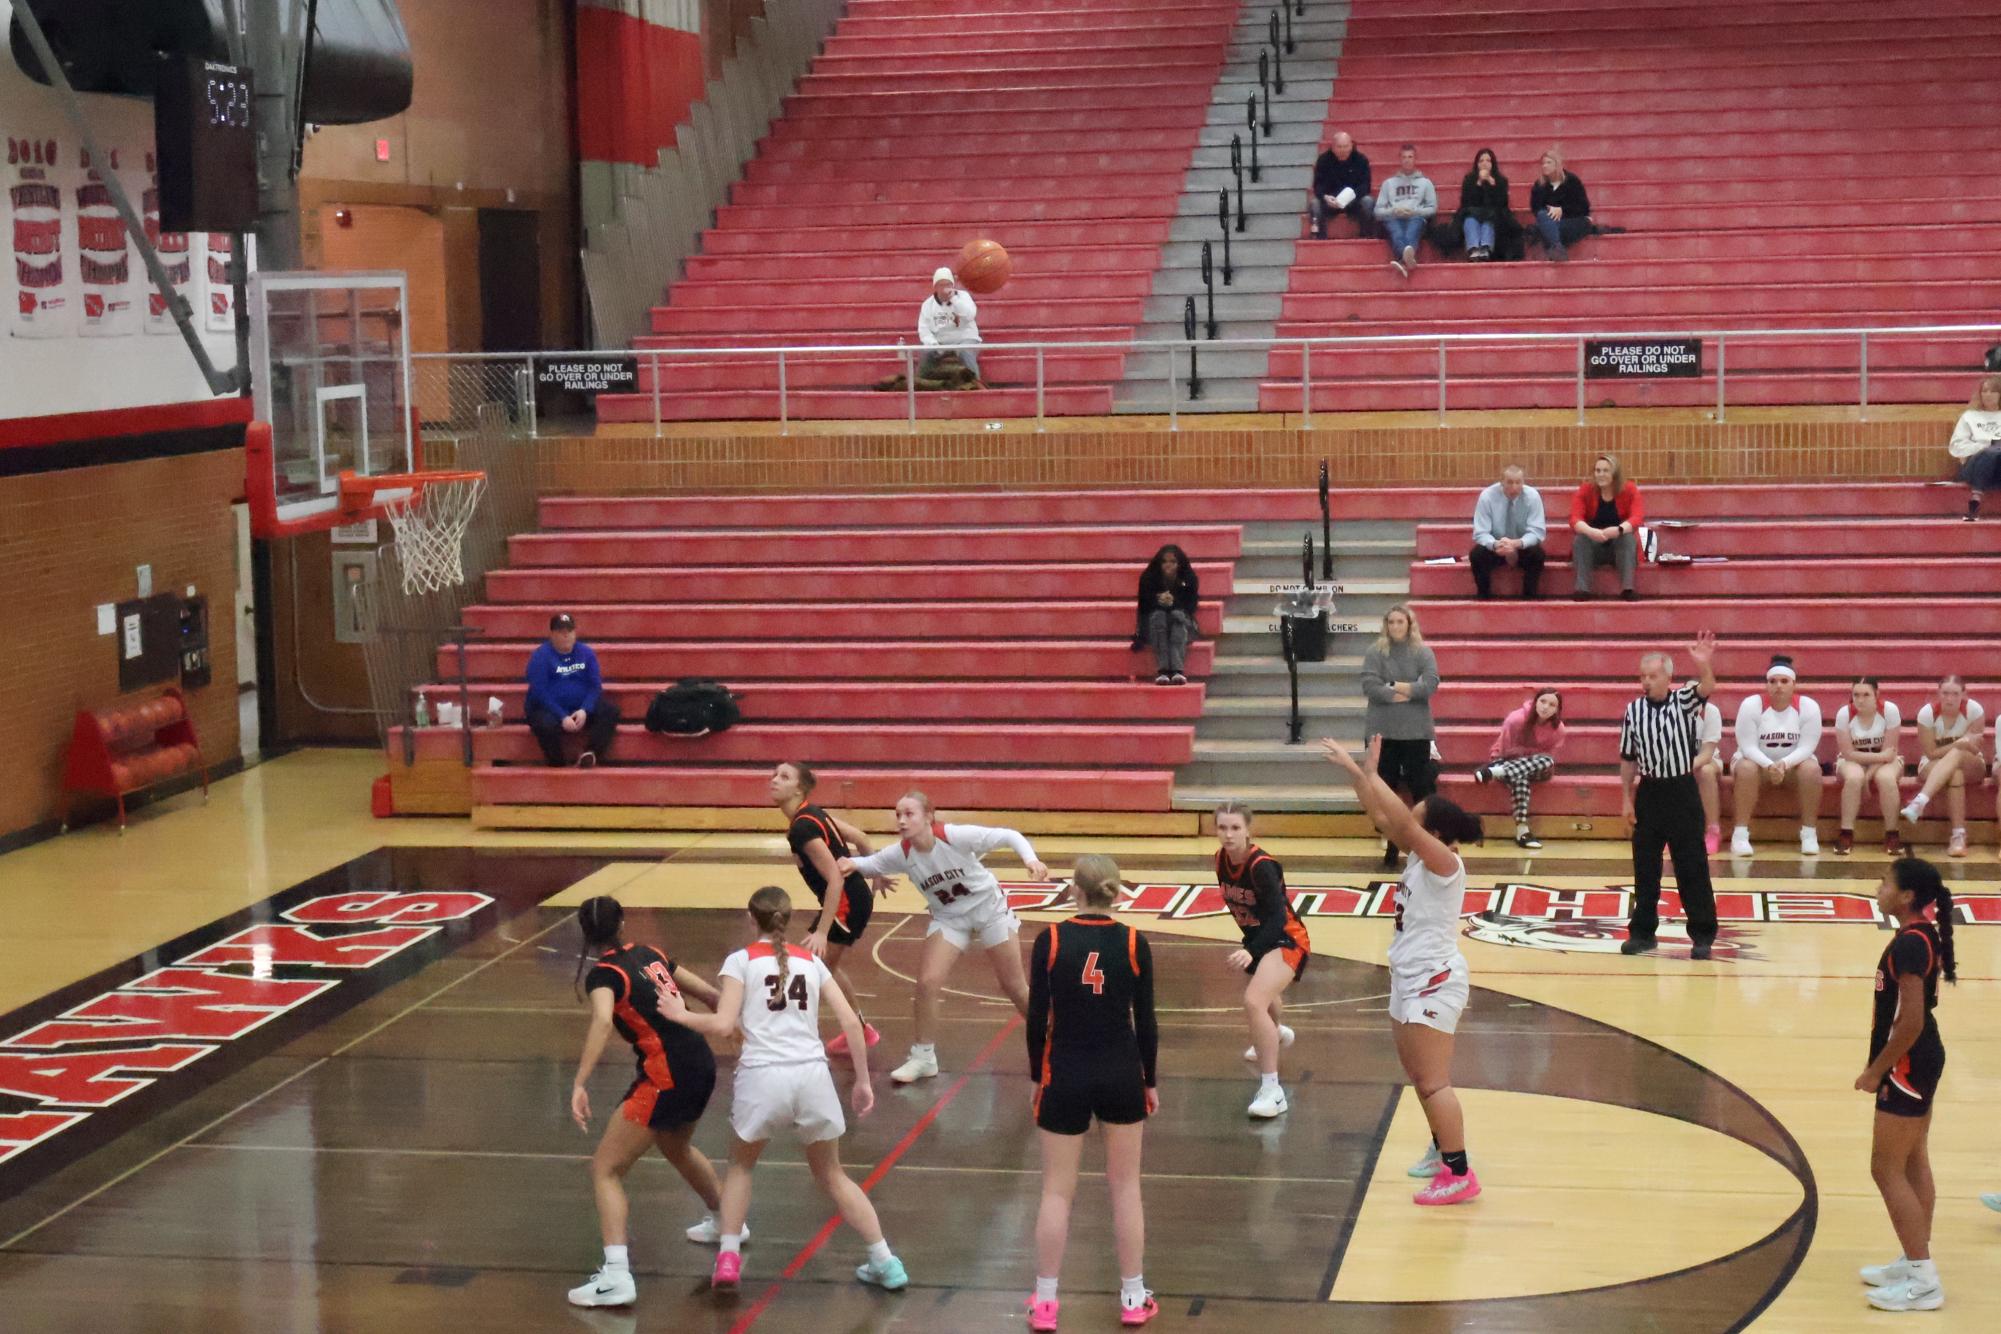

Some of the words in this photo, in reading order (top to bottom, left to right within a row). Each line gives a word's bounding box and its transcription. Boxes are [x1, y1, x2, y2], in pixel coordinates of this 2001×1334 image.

[1602, 346, 1642, 355] PLEASE
[1645, 346, 1660, 355] DO
[1663, 346, 1685, 354] NOT
[1591, 356, 1607, 365] GO
[1610, 356, 1638, 364] OVER
[1641, 355, 1656, 364] OR
[1659, 355, 1696, 363] UNDER
[548, 364, 585, 373] PLEASE
[587, 364, 601, 372] DO
[603, 363, 623, 372] NOT
[1619, 364, 1668, 373] RAILINGS
[540, 373, 554, 381] GO
[556, 373, 581, 381] OVER
[600, 372, 633, 380] UNDER
[564, 380, 608, 389] RAILINGS
[1332, 585, 1344, 593] ON
[1760, 732, 1785, 741] MASON
[943, 868, 966, 881] CITY
[1082, 952, 1104, 994] 4
[764, 974, 808, 1012] 34
